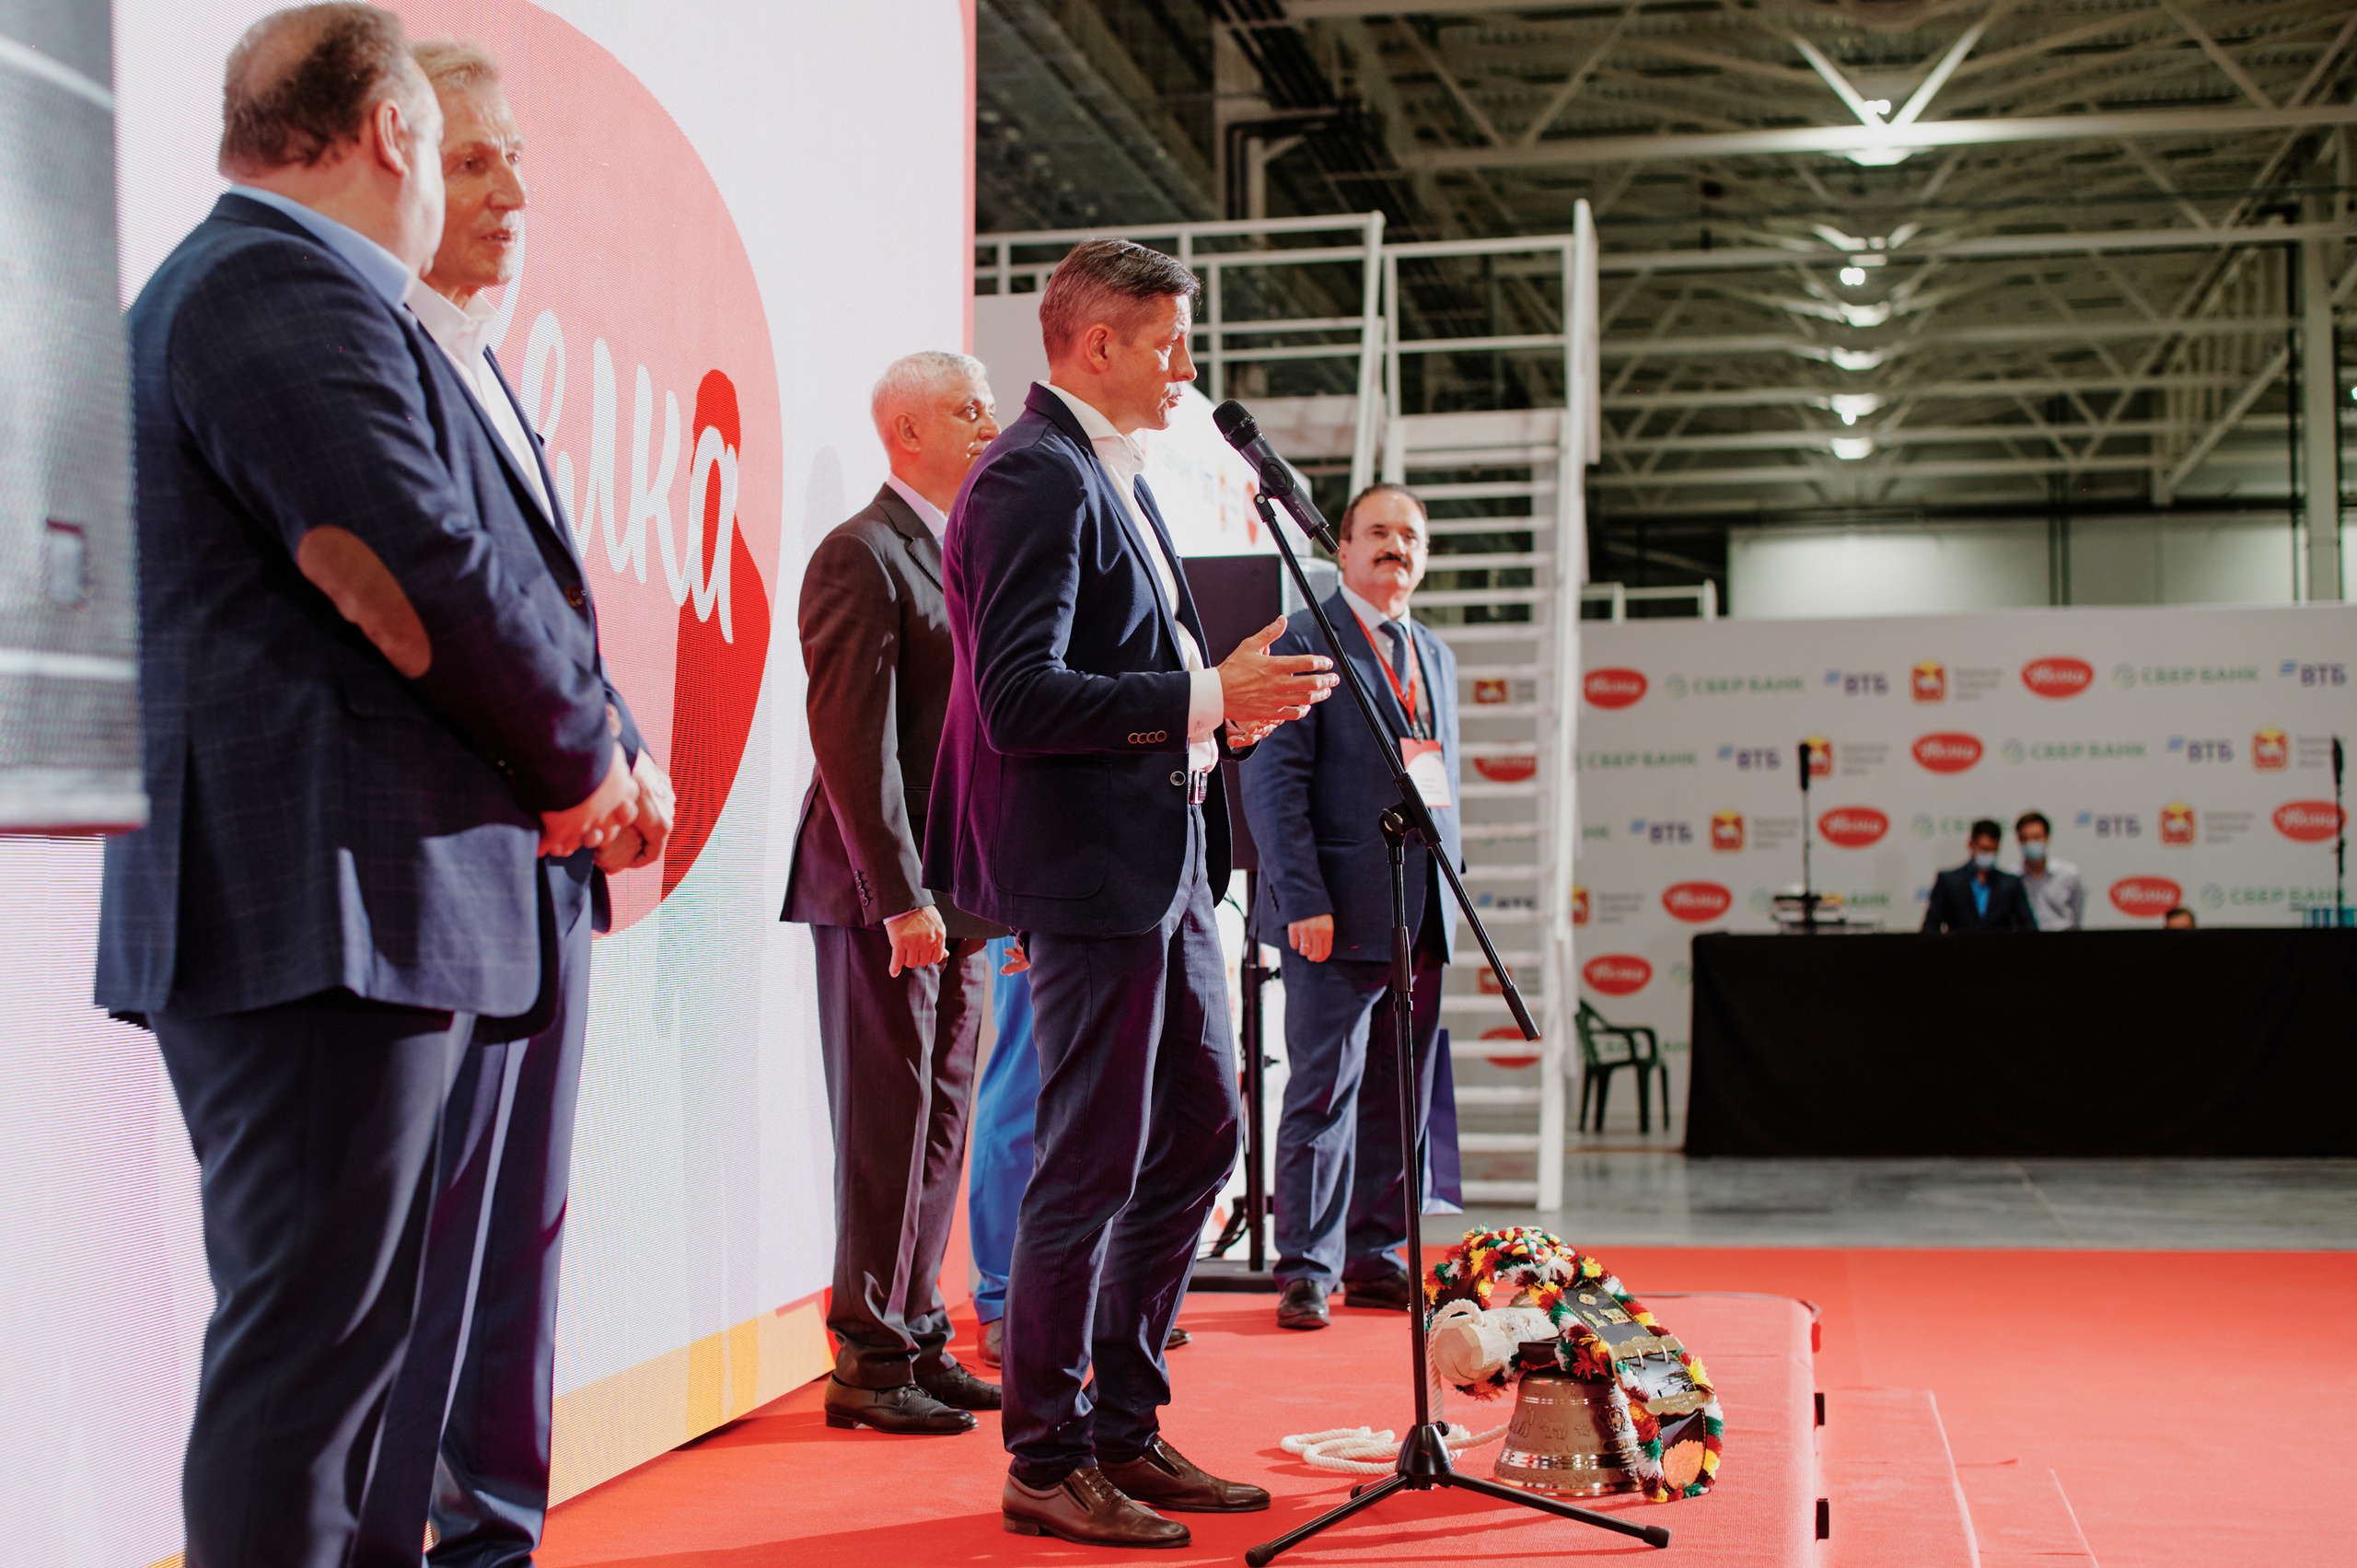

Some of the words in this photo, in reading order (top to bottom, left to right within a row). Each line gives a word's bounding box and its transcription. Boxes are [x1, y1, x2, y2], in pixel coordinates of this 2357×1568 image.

[491, 210, 737, 644] елка
[1844, 672, 1889, 696] ВТБ
[2301, 663, 2347, 687] ВТБ
[1736, 748, 1781, 771] ВТБ
[2188, 739, 2235, 763] ВТБ
[1650, 821, 1693, 843] ВТБ
[2096, 814, 2142, 839] ВТБ
